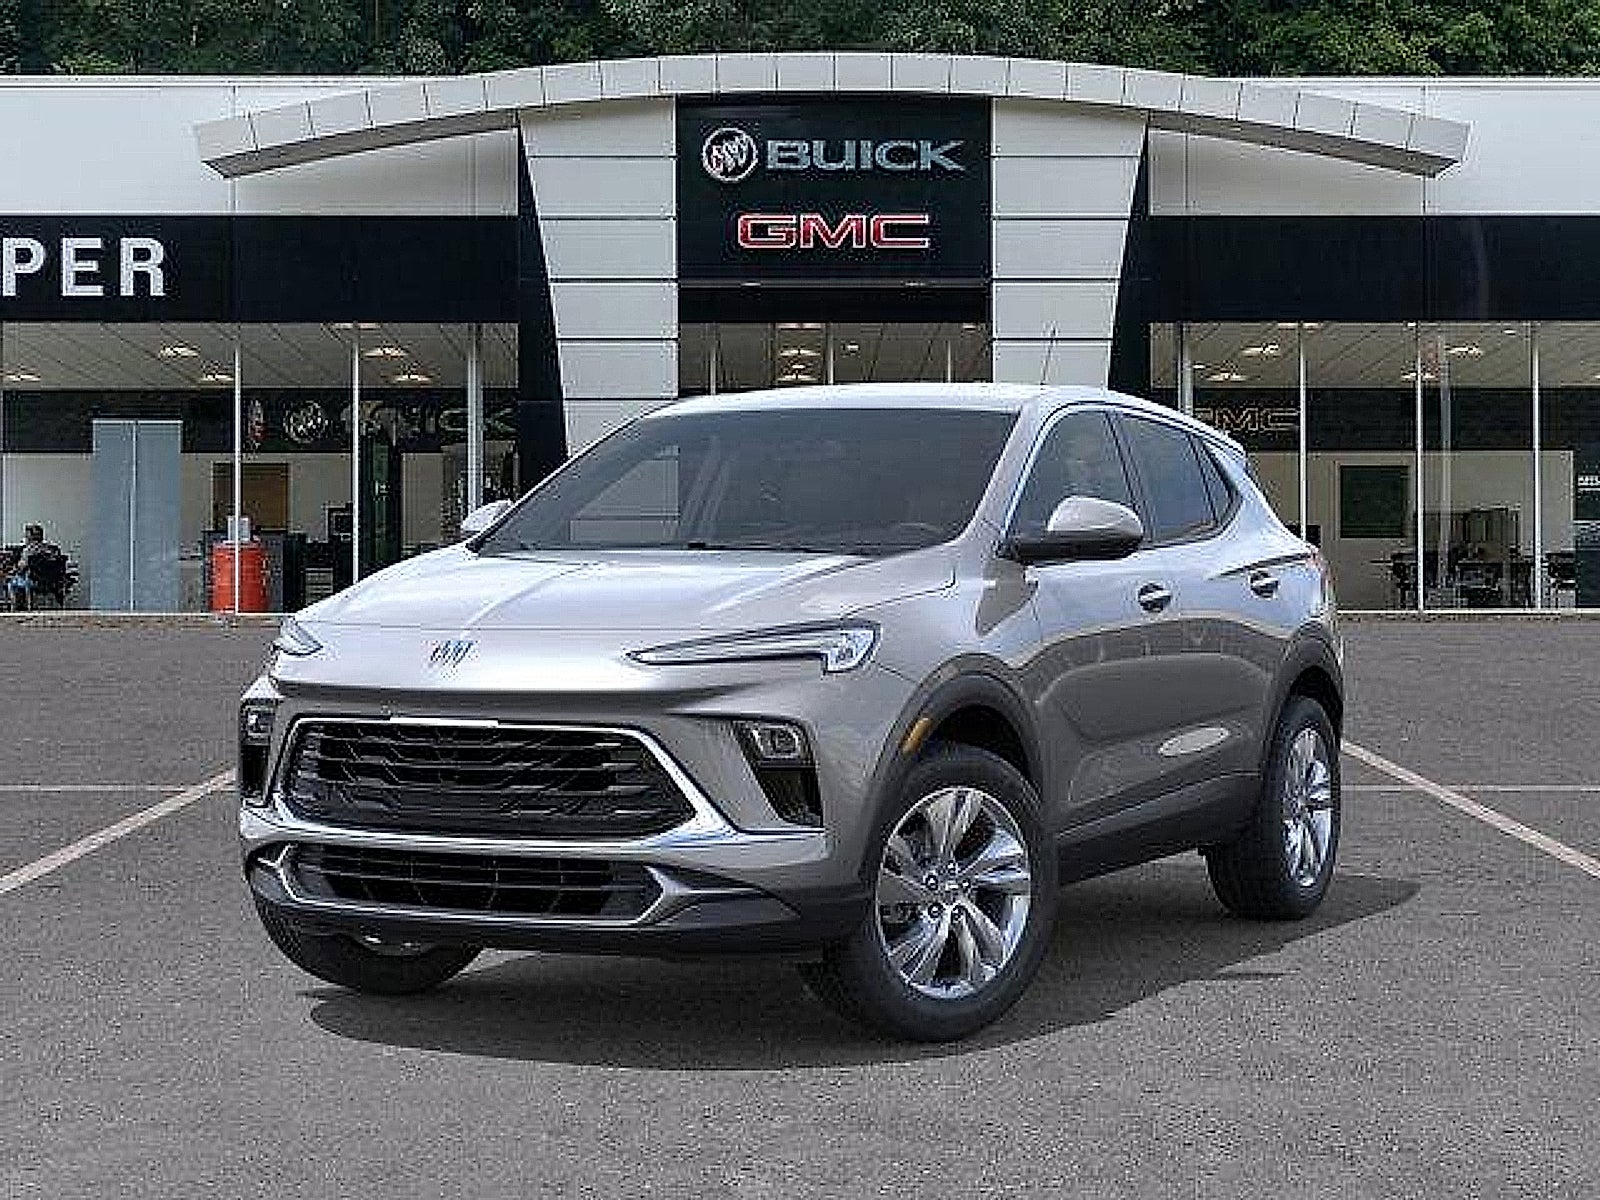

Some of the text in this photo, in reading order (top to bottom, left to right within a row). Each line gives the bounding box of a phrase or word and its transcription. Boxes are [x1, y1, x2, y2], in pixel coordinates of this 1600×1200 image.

[767, 139, 965, 170] BUICK
[738, 214, 929, 249] GMC
[2, 237, 166, 297] PER
